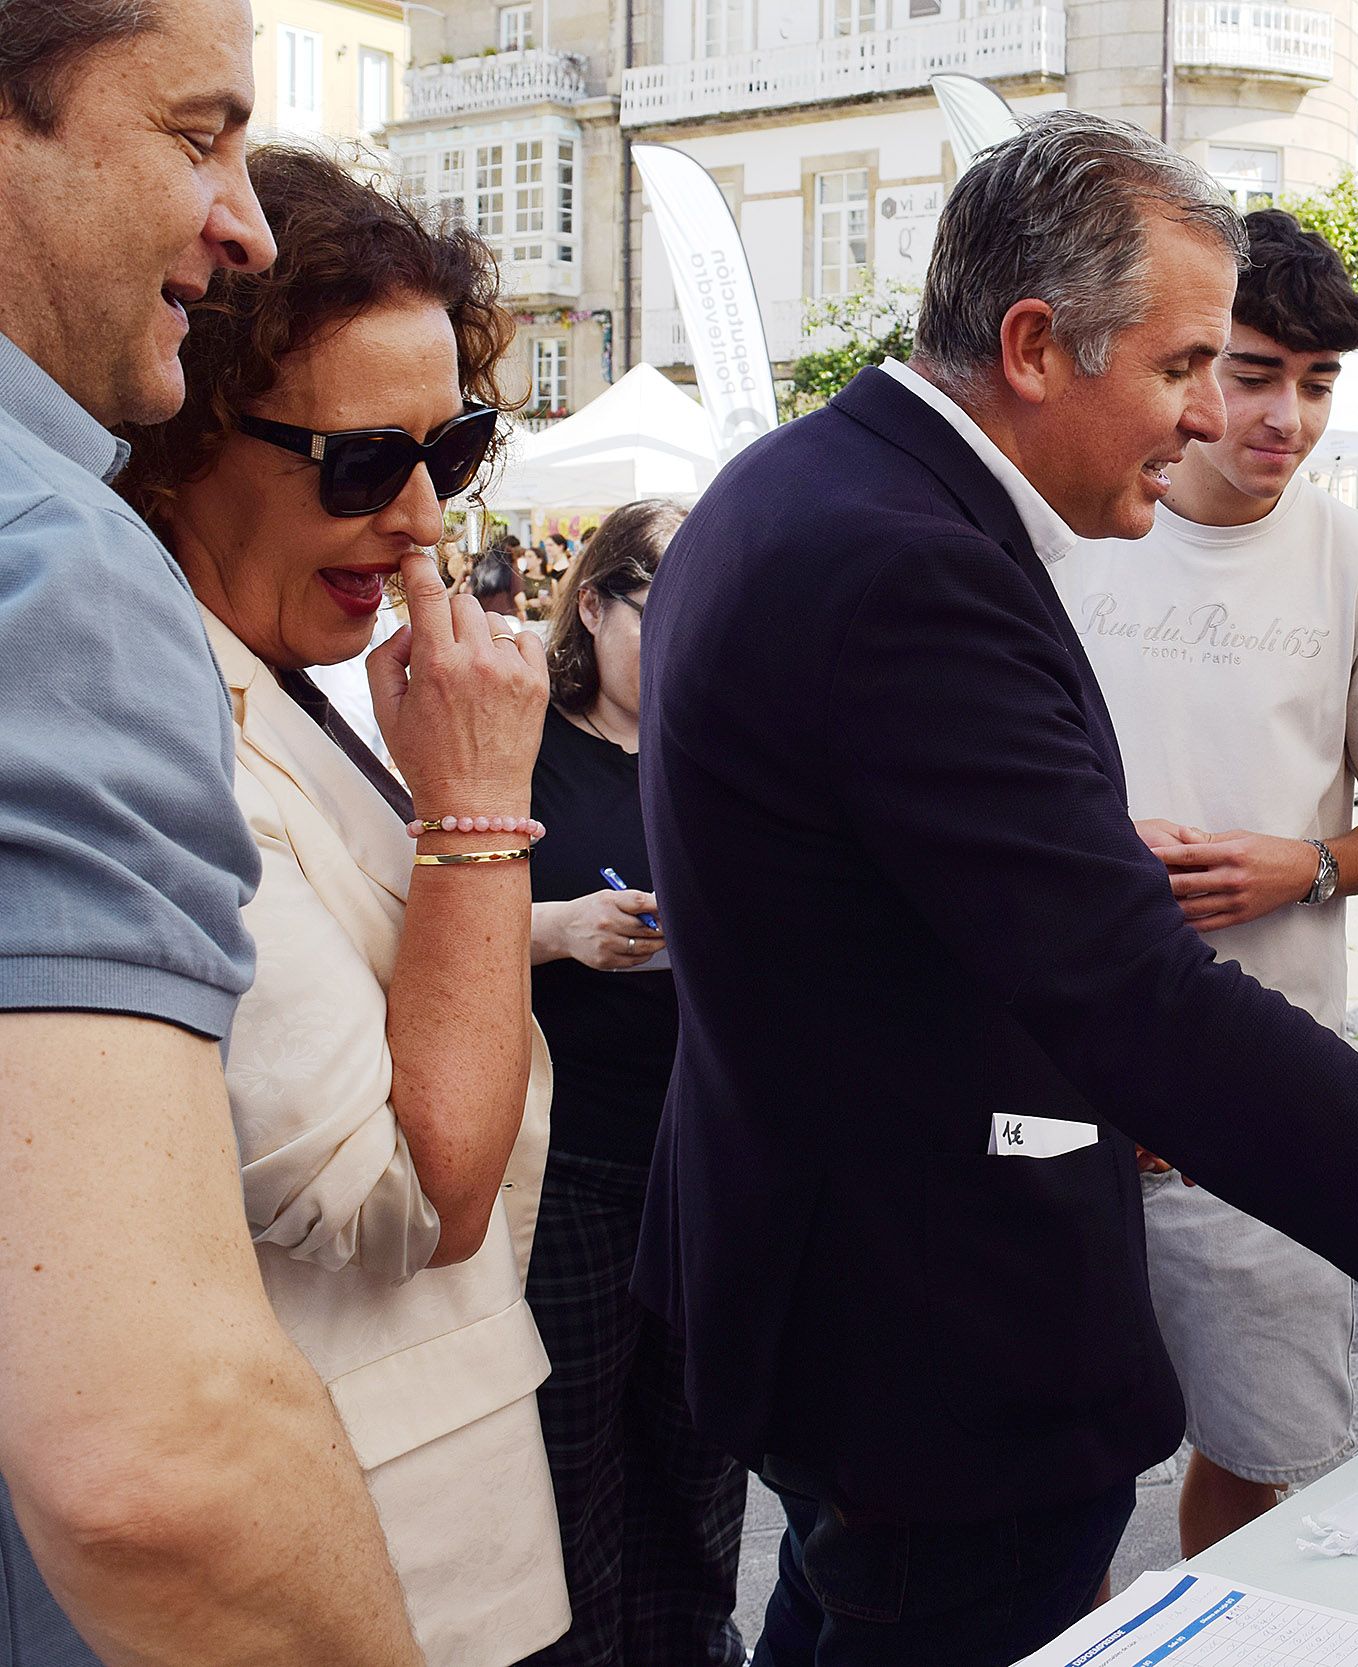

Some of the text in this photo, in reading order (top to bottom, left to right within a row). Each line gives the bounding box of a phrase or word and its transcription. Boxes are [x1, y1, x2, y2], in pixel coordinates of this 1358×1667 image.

[1078, 592, 1330, 659] Rue du Rivoli 65
[1201, 651, 1242, 666] Paris
[1002, 1120, 1024, 1146] 1€
